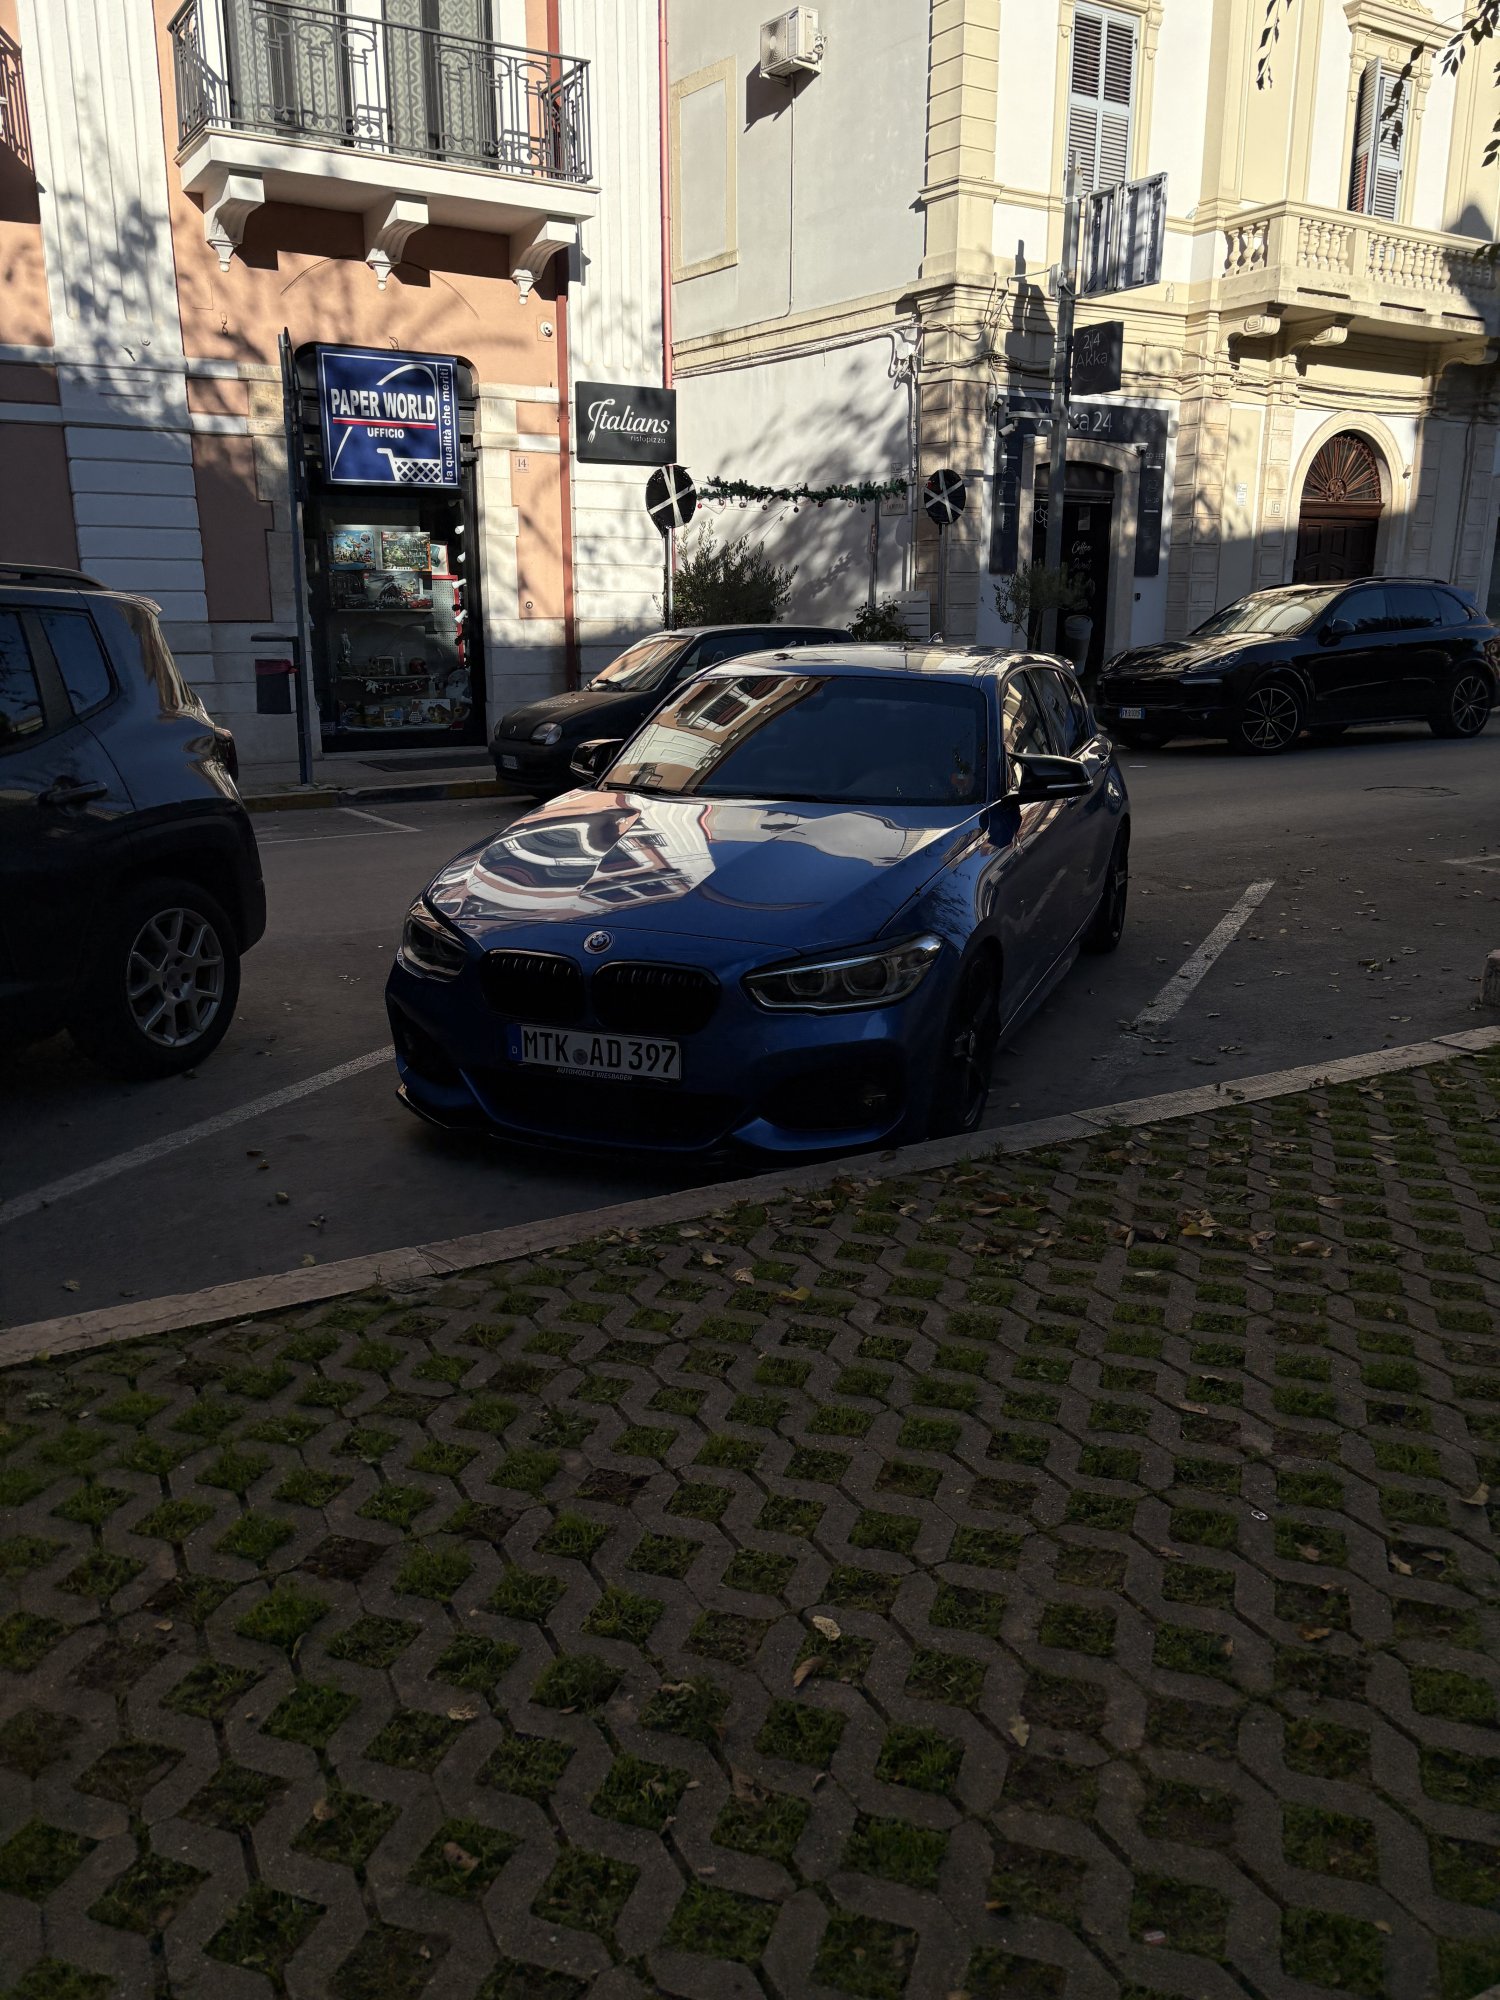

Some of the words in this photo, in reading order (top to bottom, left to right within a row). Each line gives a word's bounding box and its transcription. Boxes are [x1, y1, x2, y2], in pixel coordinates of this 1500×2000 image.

[1075, 350, 1108, 369] Akka
[439, 367, 450, 401] meriti
[330, 388, 381, 418] PAPER
[382, 391, 436, 421] WORLD
[442, 404, 451, 426] che
[587, 398, 671, 444] Italians
[1038, 405, 1090, 431] Aka
[1092, 410, 1113, 432] 24
[366, 426, 405, 439] UFFICIO
[630, 435, 666, 444] ristopizza
[443, 429, 455, 468] qualità
[517, 458, 527, 468] 14
[444, 470, 454, 481] la
[523, 1030, 569, 1063] MTK
[589, 1037, 622, 1068] AD
[628, 1041, 677, 1073] 397
